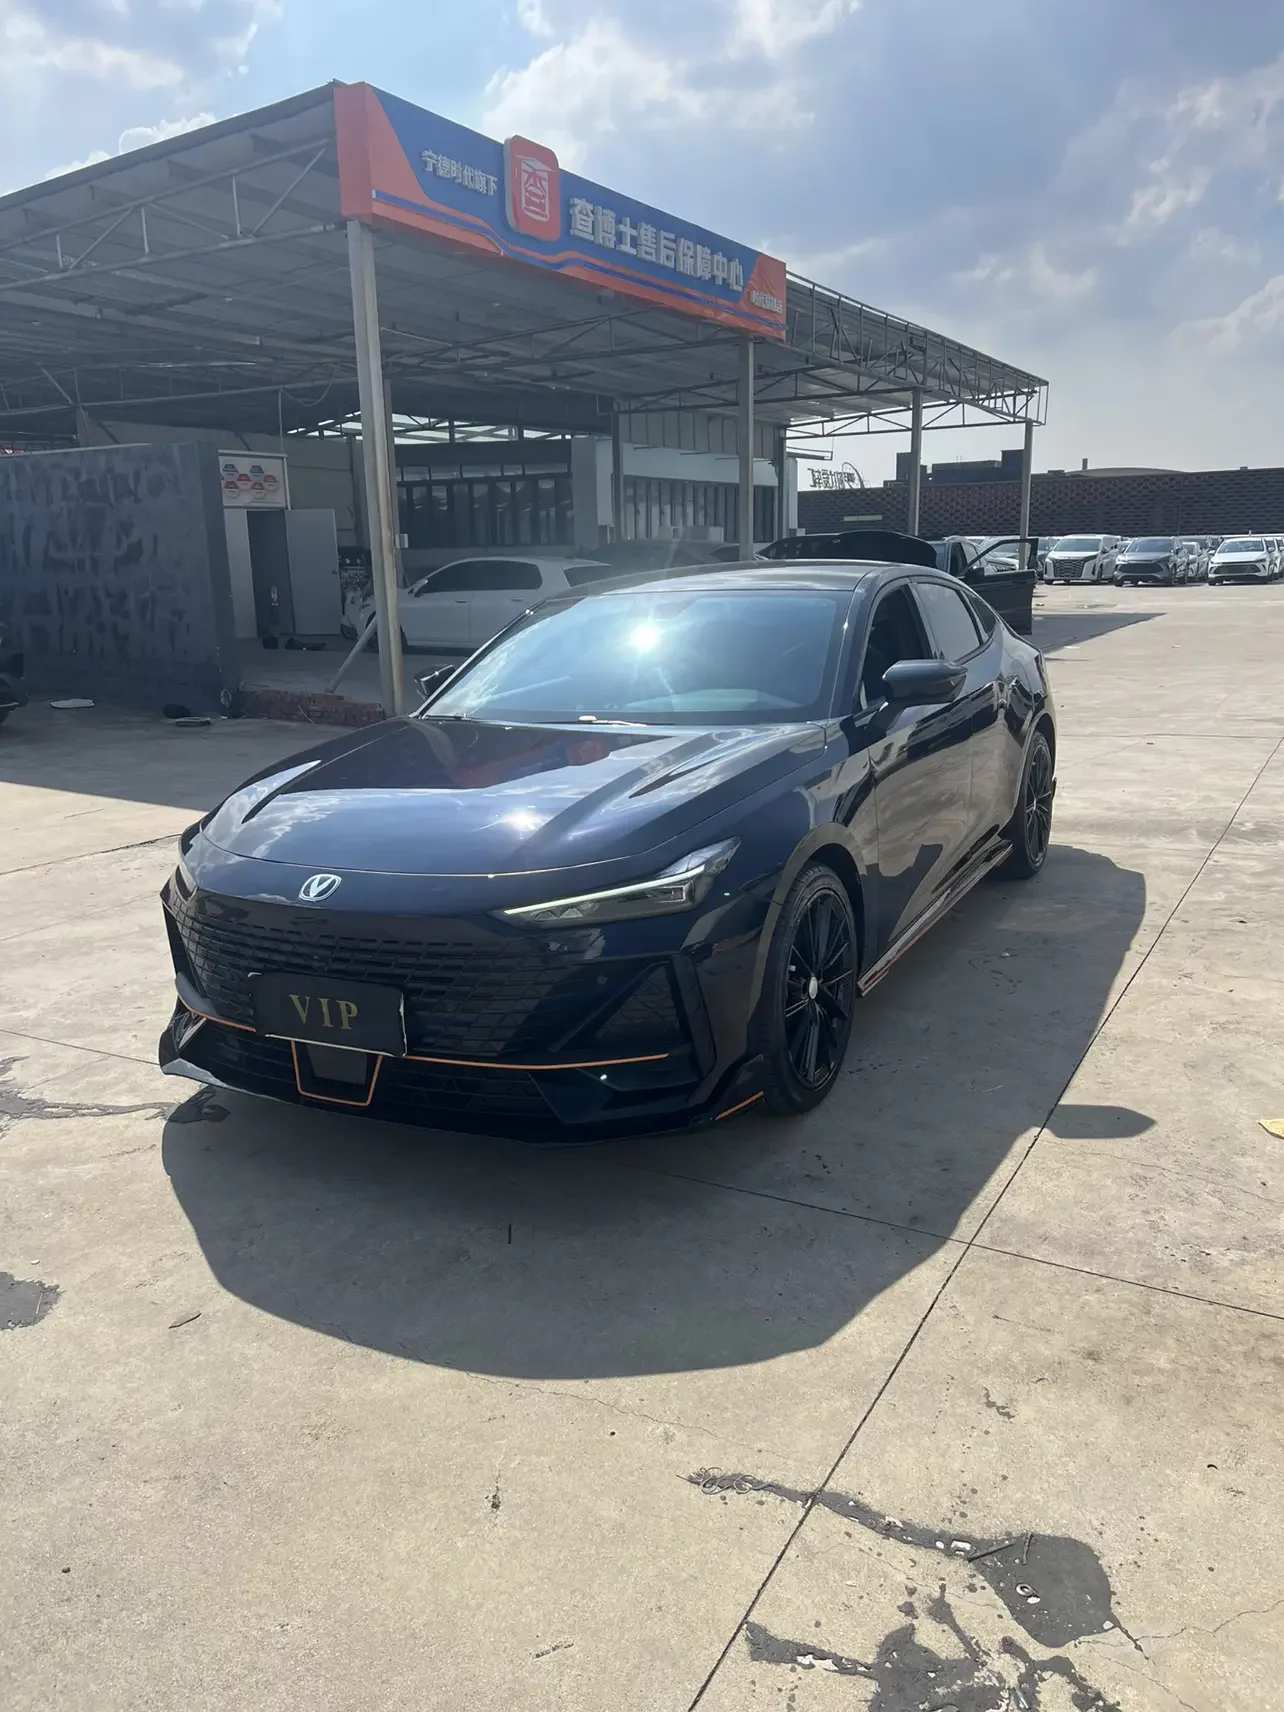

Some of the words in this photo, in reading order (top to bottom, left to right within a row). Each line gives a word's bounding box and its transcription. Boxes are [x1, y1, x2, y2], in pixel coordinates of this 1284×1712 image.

[421, 148, 499, 196] 宁德时代旗下
[569, 197, 744, 292] 查博士售后保障中心
[288, 994, 358, 1030] VIP
